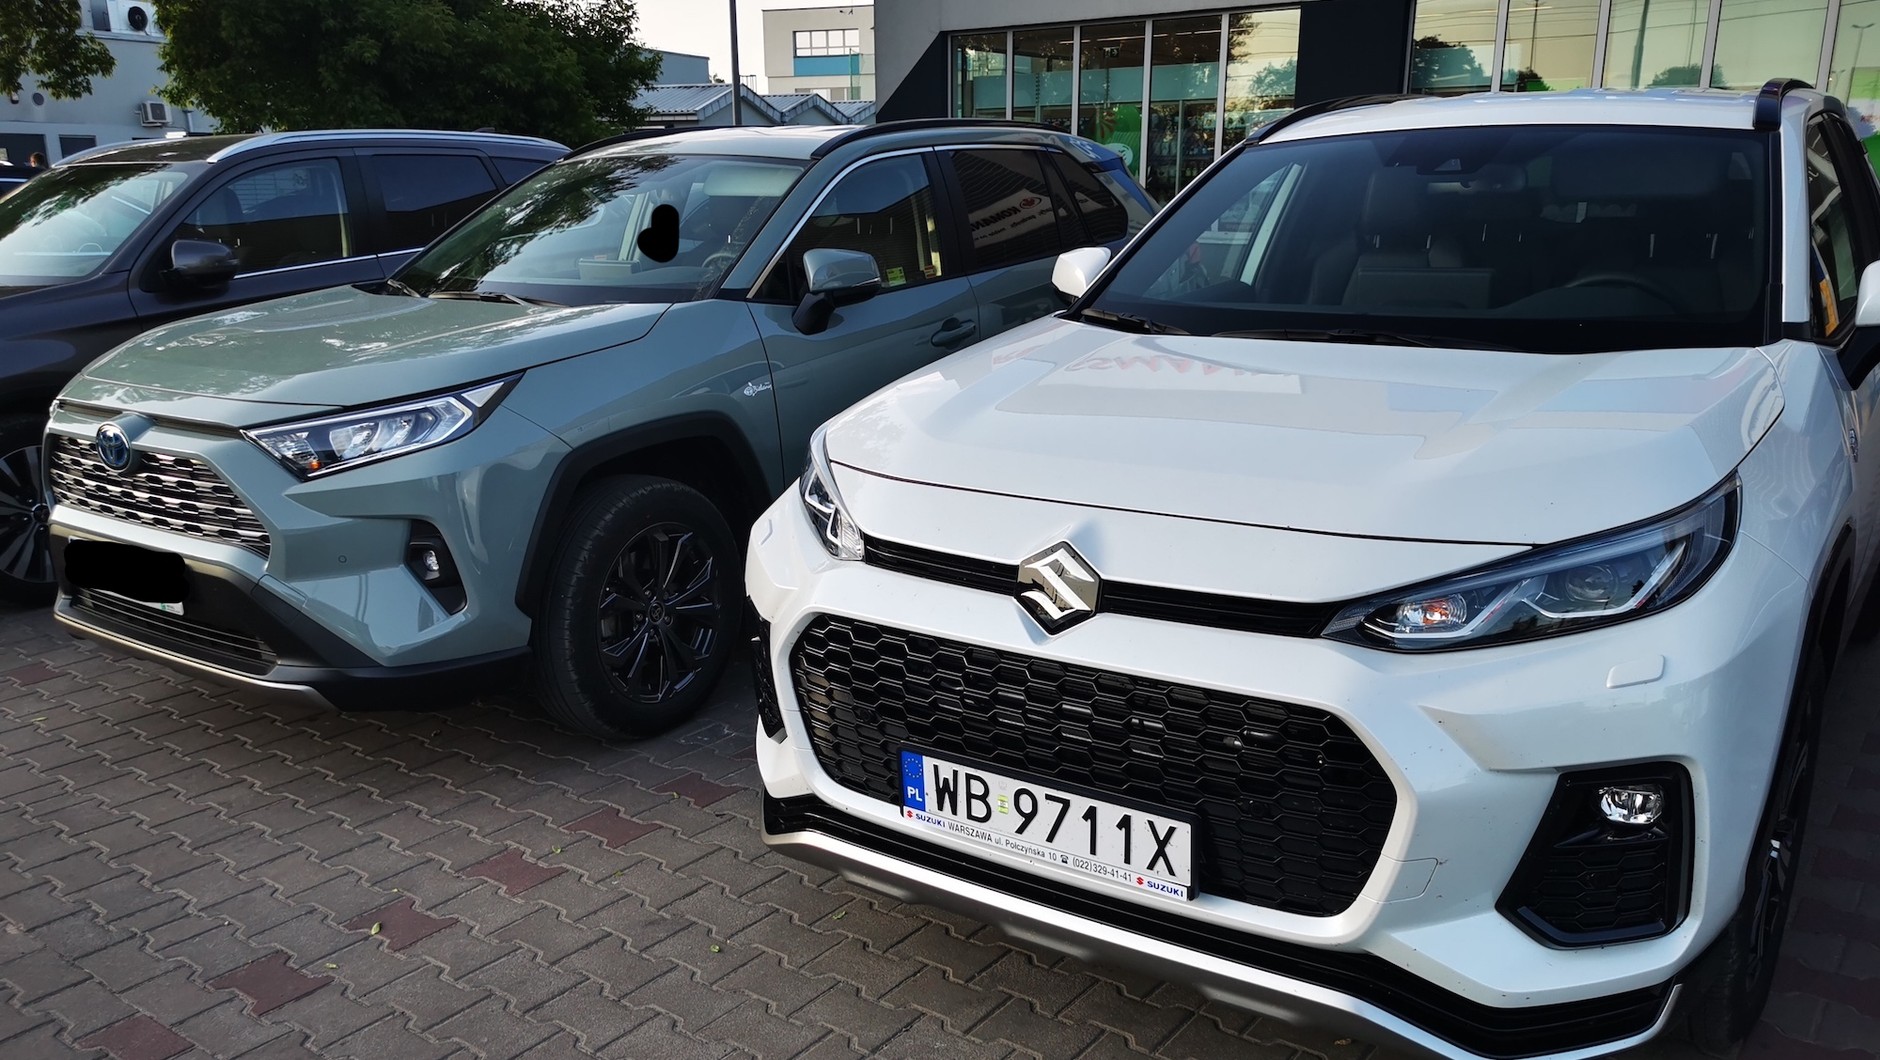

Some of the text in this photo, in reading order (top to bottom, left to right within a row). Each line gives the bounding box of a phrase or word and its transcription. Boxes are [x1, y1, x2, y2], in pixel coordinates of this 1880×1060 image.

[907, 786, 923, 801] PL
[933, 764, 1177, 877] WB 9711X
[915, 813, 946, 828] SUZUKI
[947, 821, 993, 843] WARSZAWA
[1048, 852, 1057, 861] 10
[1147, 880, 1184, 898] SUZUKI
